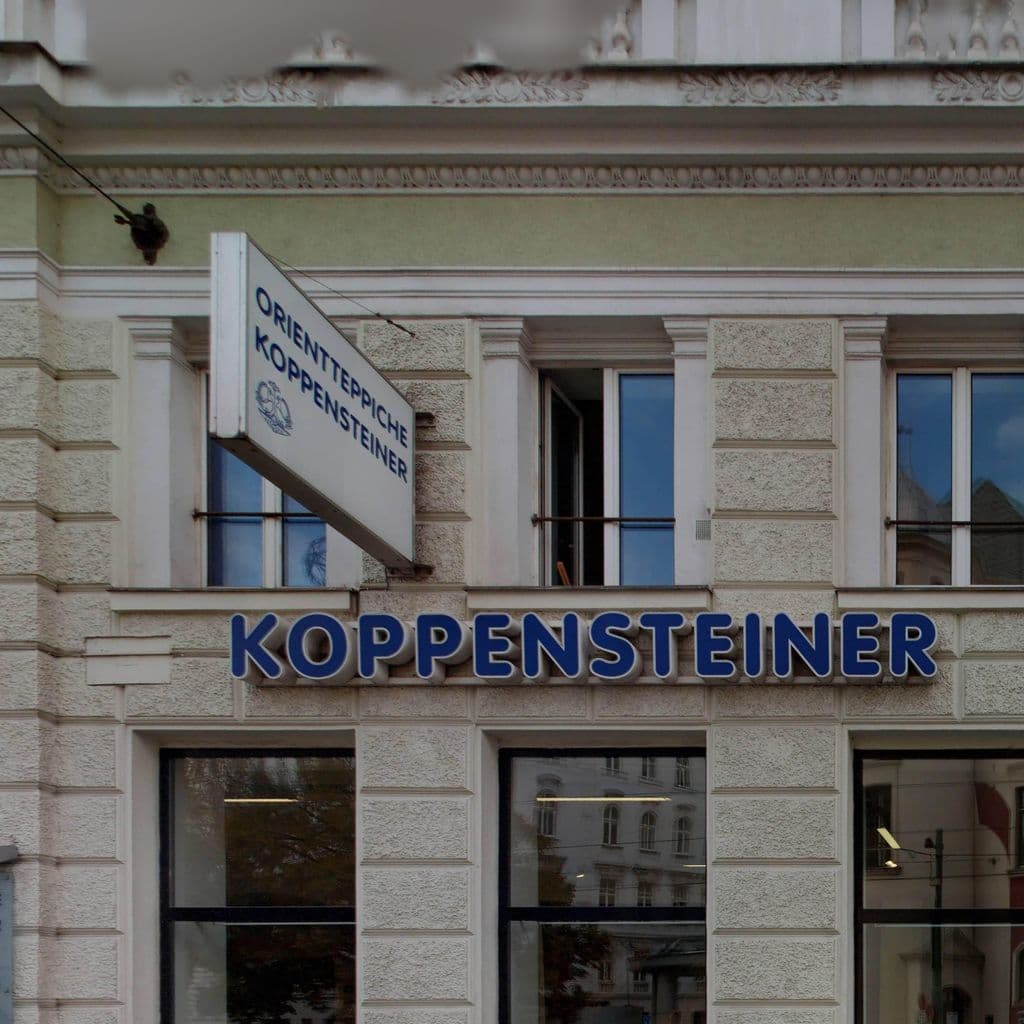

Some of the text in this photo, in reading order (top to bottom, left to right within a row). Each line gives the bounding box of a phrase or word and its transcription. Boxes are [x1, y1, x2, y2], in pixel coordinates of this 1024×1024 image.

[255, 286, 408, 449] ORIENTTEPPICHE
[255, 324, 408, 484] KOPPENSTEINER
[230, 612, 938, 681] KOPPENSTEINER
